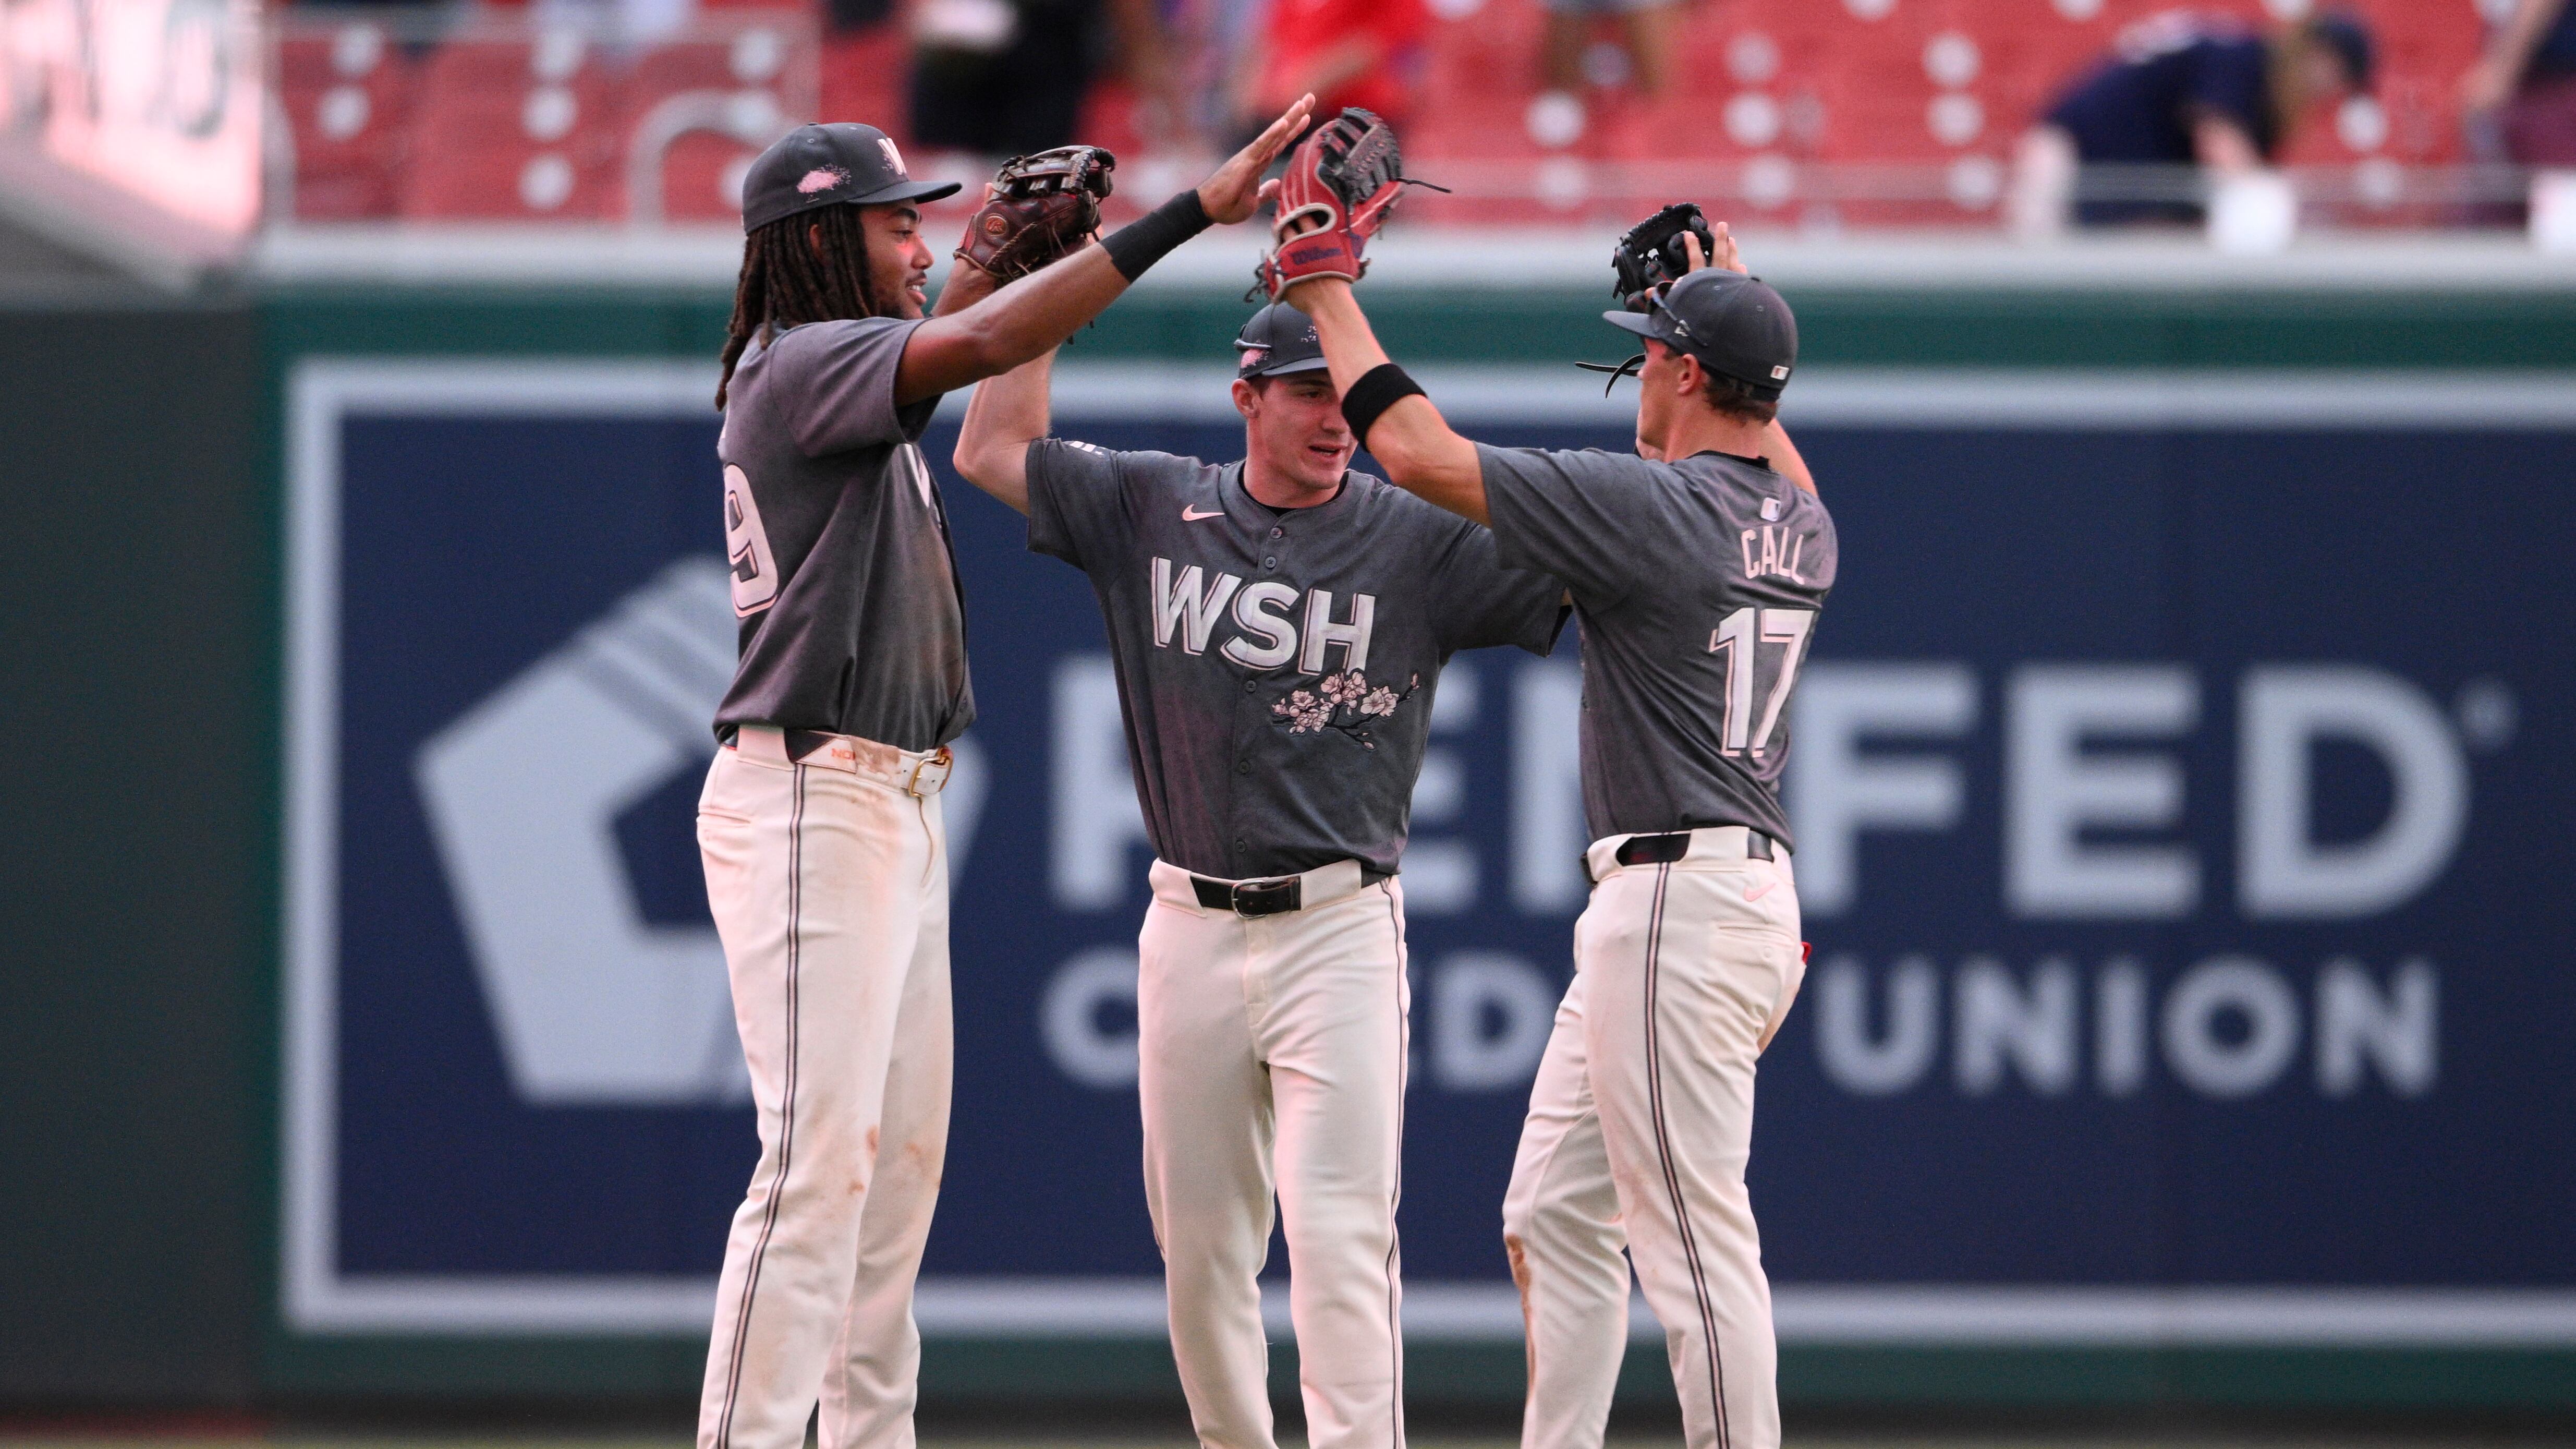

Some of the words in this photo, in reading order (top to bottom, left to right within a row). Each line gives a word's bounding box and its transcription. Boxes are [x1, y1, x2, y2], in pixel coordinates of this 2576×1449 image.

[1151, 556, 1376, 677] WSH
[1741, 525, 1805, 585] CALL
[1709, 607, 1815, 757] 17
[1814, 955, 2436, 1094] UNION
